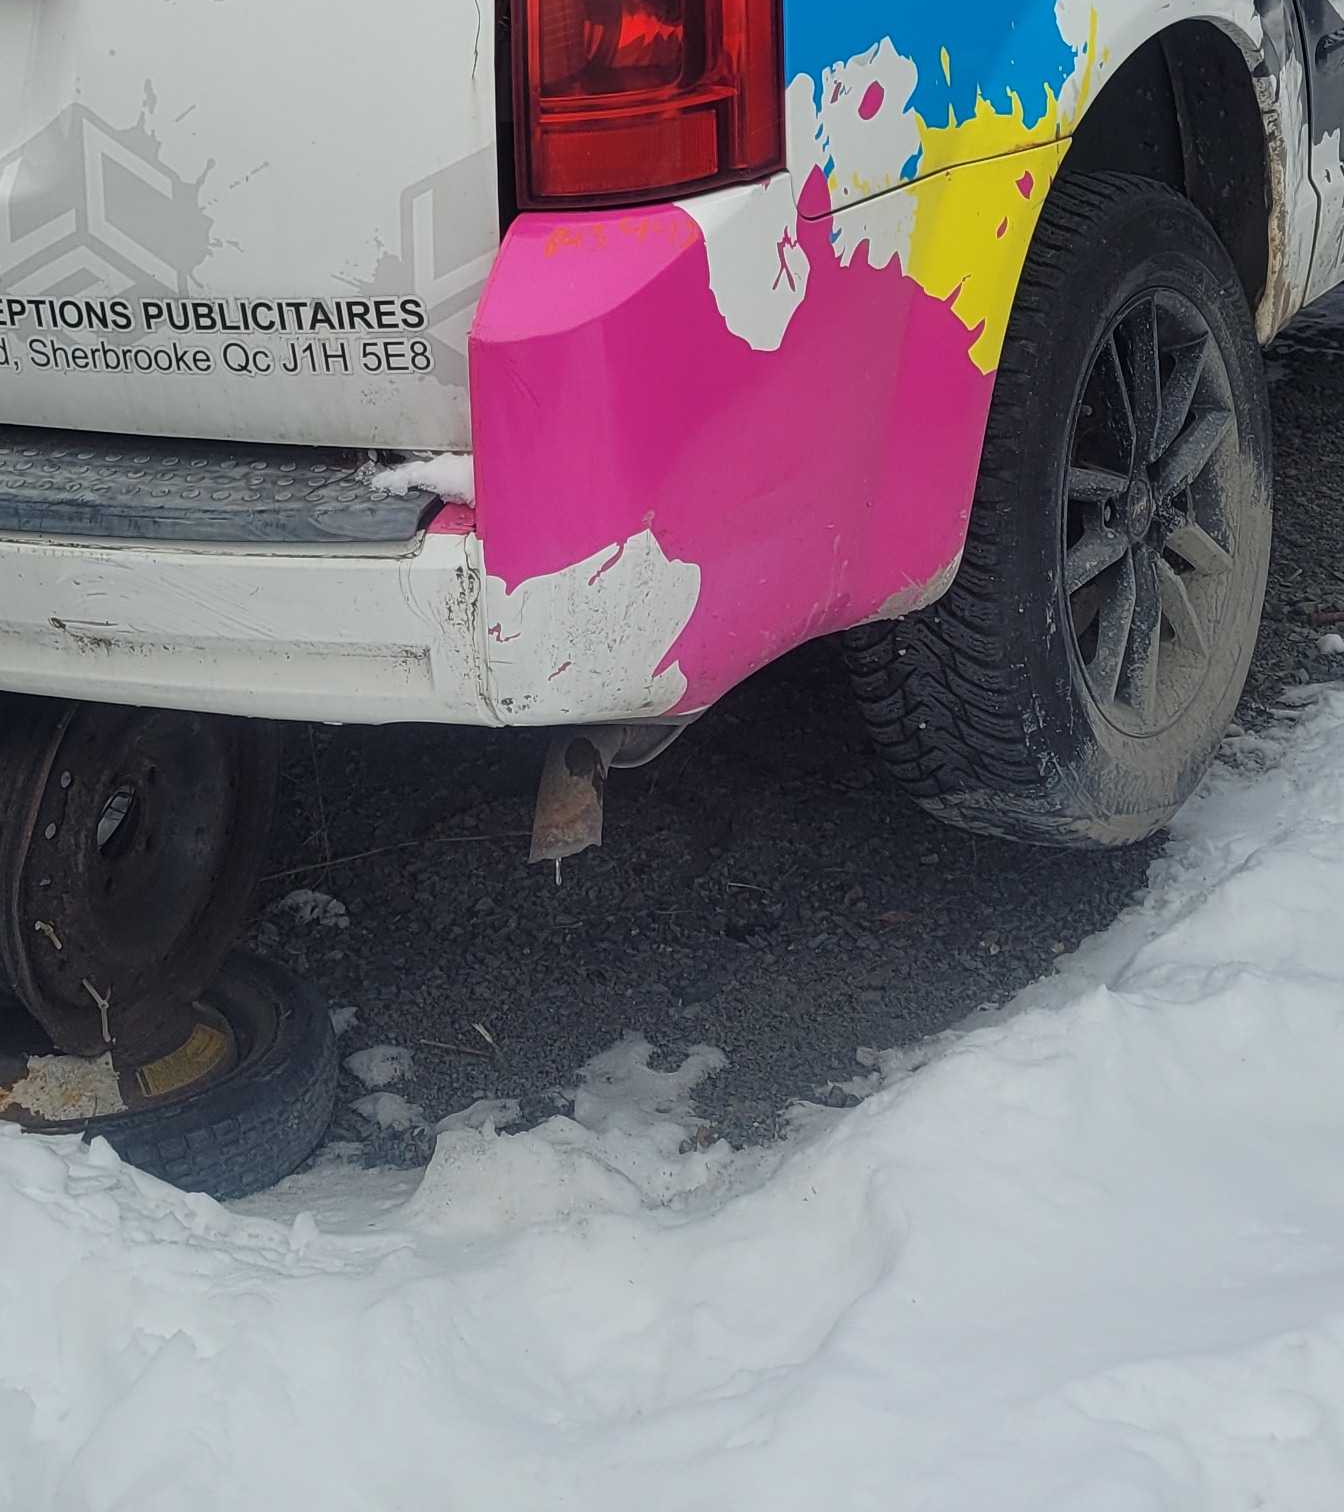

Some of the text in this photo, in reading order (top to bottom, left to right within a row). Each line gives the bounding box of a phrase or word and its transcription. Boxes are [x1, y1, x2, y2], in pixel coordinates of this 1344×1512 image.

[143, 299, 426, 332] PUBLICITAIRES
[29, 337, 213, 374] Sherbrooke
[223, 341, 273, 376] Qc
[282, 341, 350, 373] J1H
[362, 340, 433, 373] 5E8
